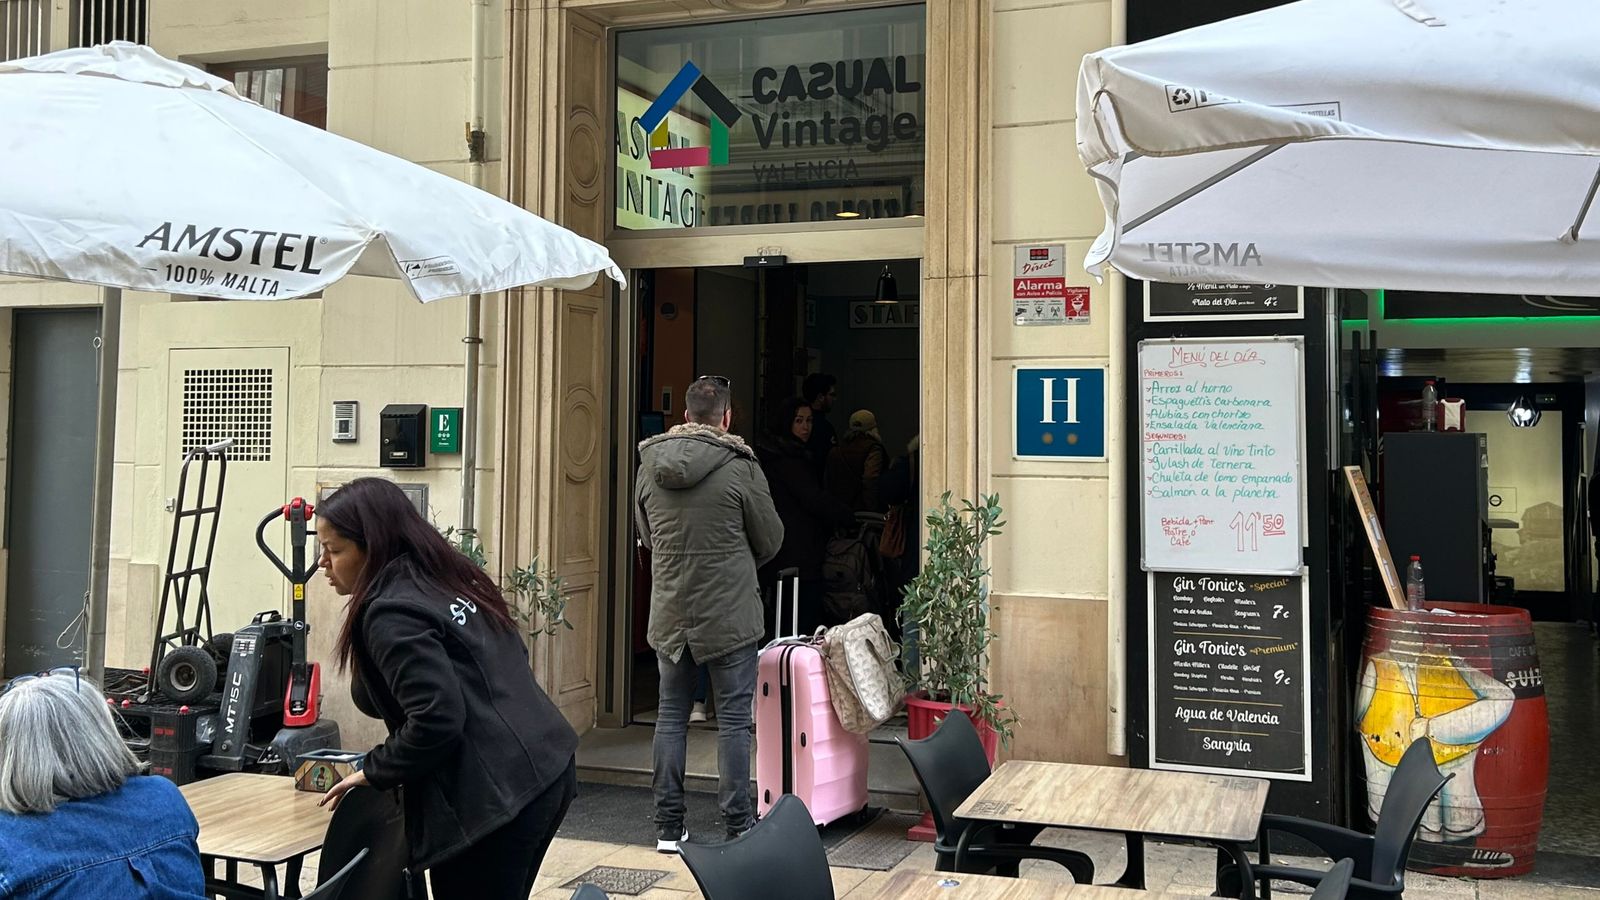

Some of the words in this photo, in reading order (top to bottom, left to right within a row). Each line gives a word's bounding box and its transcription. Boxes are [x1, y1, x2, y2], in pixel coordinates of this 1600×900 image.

[752, 55, 921, 104] CASUAL
[751, 111, 918, 152] Vintage
[753, 158, 859, 183] VALENCIA
[136, 221, 323, 275] AMSTEL
[165, 263, 214, 286] 100%
[220, 272, 280, 297] MALTA
[1017, 280, 1063, 291] Alarma
[1192, 298, 1211, 306] Plato
[1211, 297, 1223, 306] del
[1172, 346, 1206, 364] MENÚ
[1209, 349, 1229, 362] DEL
[1233, 348, 1258, 362] DÍA
[1151, 380, 1182, 394] Arroz
[1186, 380, 1199, 393] al
[1201, 380, 1233, 393] horno
[1039, 377, 1081, 424] H
[1151, 395, 1212, 410] Espaguettis
[1150, 408, 1189, 419] Alubias
[1192, 411, 1210, 419] con
[439, 414, 450, 431] E
[1150, 420, 1198, 430] Ensalada
[1152, 441, 1204, 456] Carrillada
[1207, 442, 1220, 455] al
[1248, 443, 1276, 457] tinto
[1191, 458, 1204, 469] de
[1152, 471, 1192, 484] Chuleta
[1194, 473, 1208, 482] de
[1214, 472, 1237, 483] lomo
[1241, 472, 1293, 488] empanado
[1201, 488, 1210, 496] a
[1215, 485, 1226, 497] la
[1232, 485, 1279, 502] plancha
[1161, 515, 1192, 527] Bebida
[1170, 535, 1191, 547] Café
[1173, 576, 1197, 593] Gin
[1198, 577, 1247, 593] Tonic's
[1173, 639, 1197, 656] Gin
[1198, 640, 1247, 657] Tonic's
[225, 671, 242, 734] MT15C
[1175, 706, 1207, 723] Agua
[1209, 708, 1225, 721] de
[1225, 709, 1280, 725] Valencia
